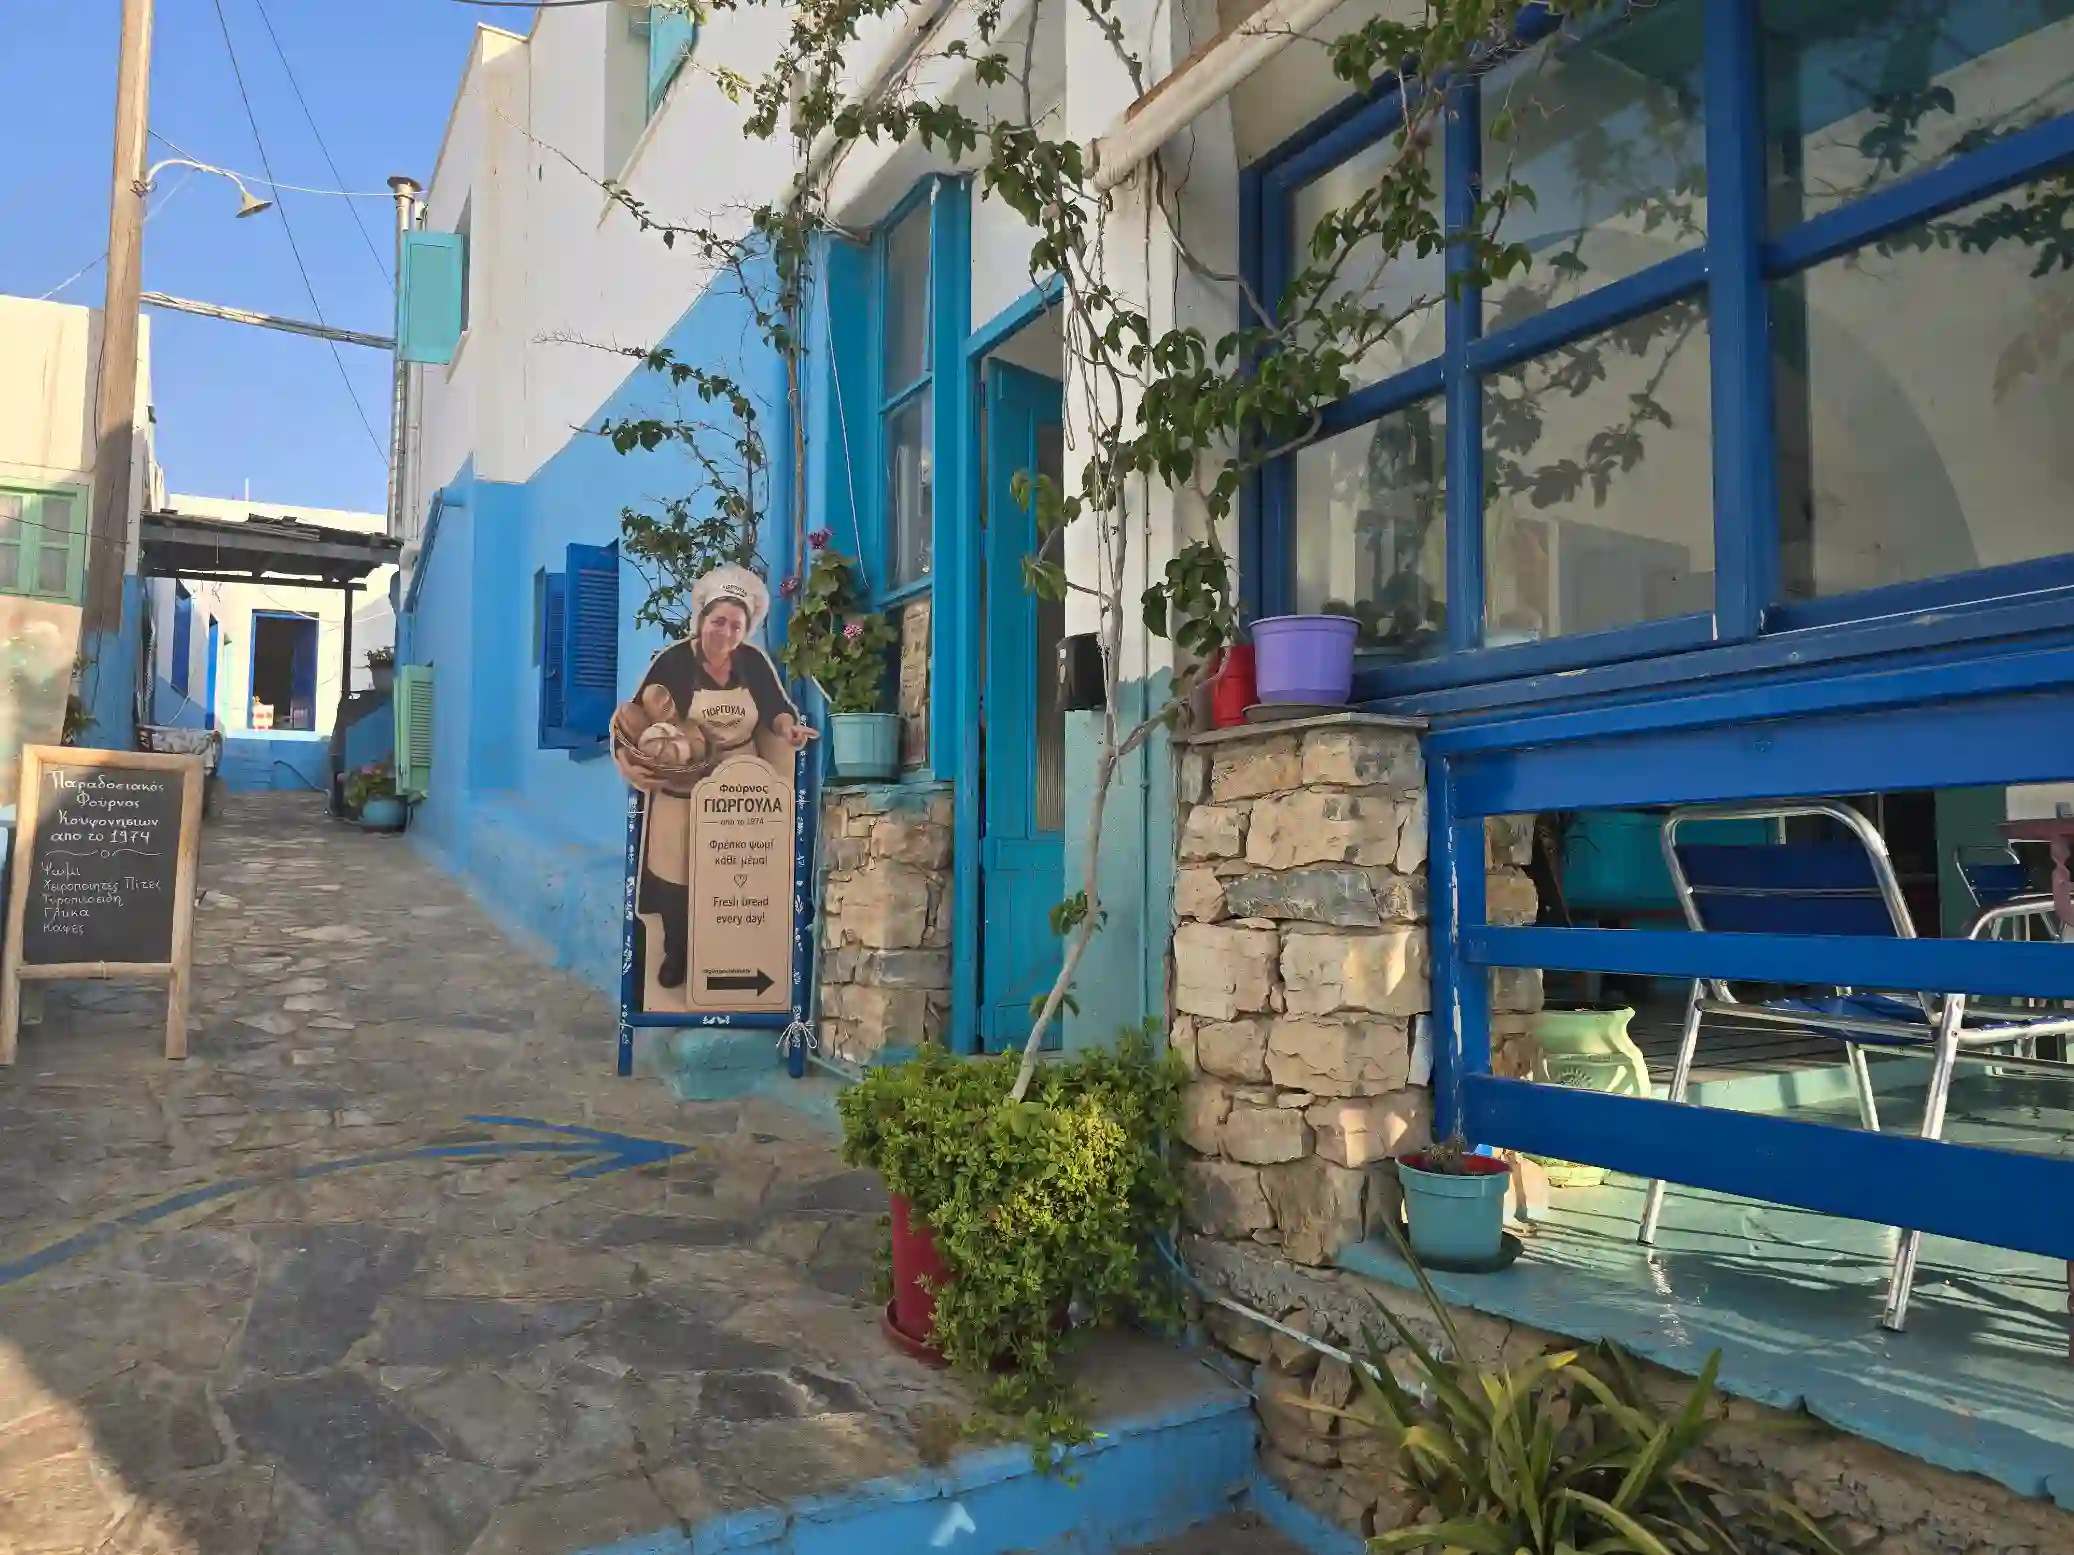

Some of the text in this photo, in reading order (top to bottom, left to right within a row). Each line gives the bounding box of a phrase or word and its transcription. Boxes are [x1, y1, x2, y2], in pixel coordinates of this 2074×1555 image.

[719, 783, 769, 795] Φούρνος
[704, 797, 783, 813] ΓΙΩΡΓΟΥΛΑ
[747, 817, 765, 826] 1974
[88, 832, 104, 841] το
[109, 829, 150, 844] 1974
[749, 837, 775, 852] ψωμί
[715, 855, 737, 865] κάθε
[713, 895, 769, 907] Fresh bread
[716, 911, 765, 925] every day!
